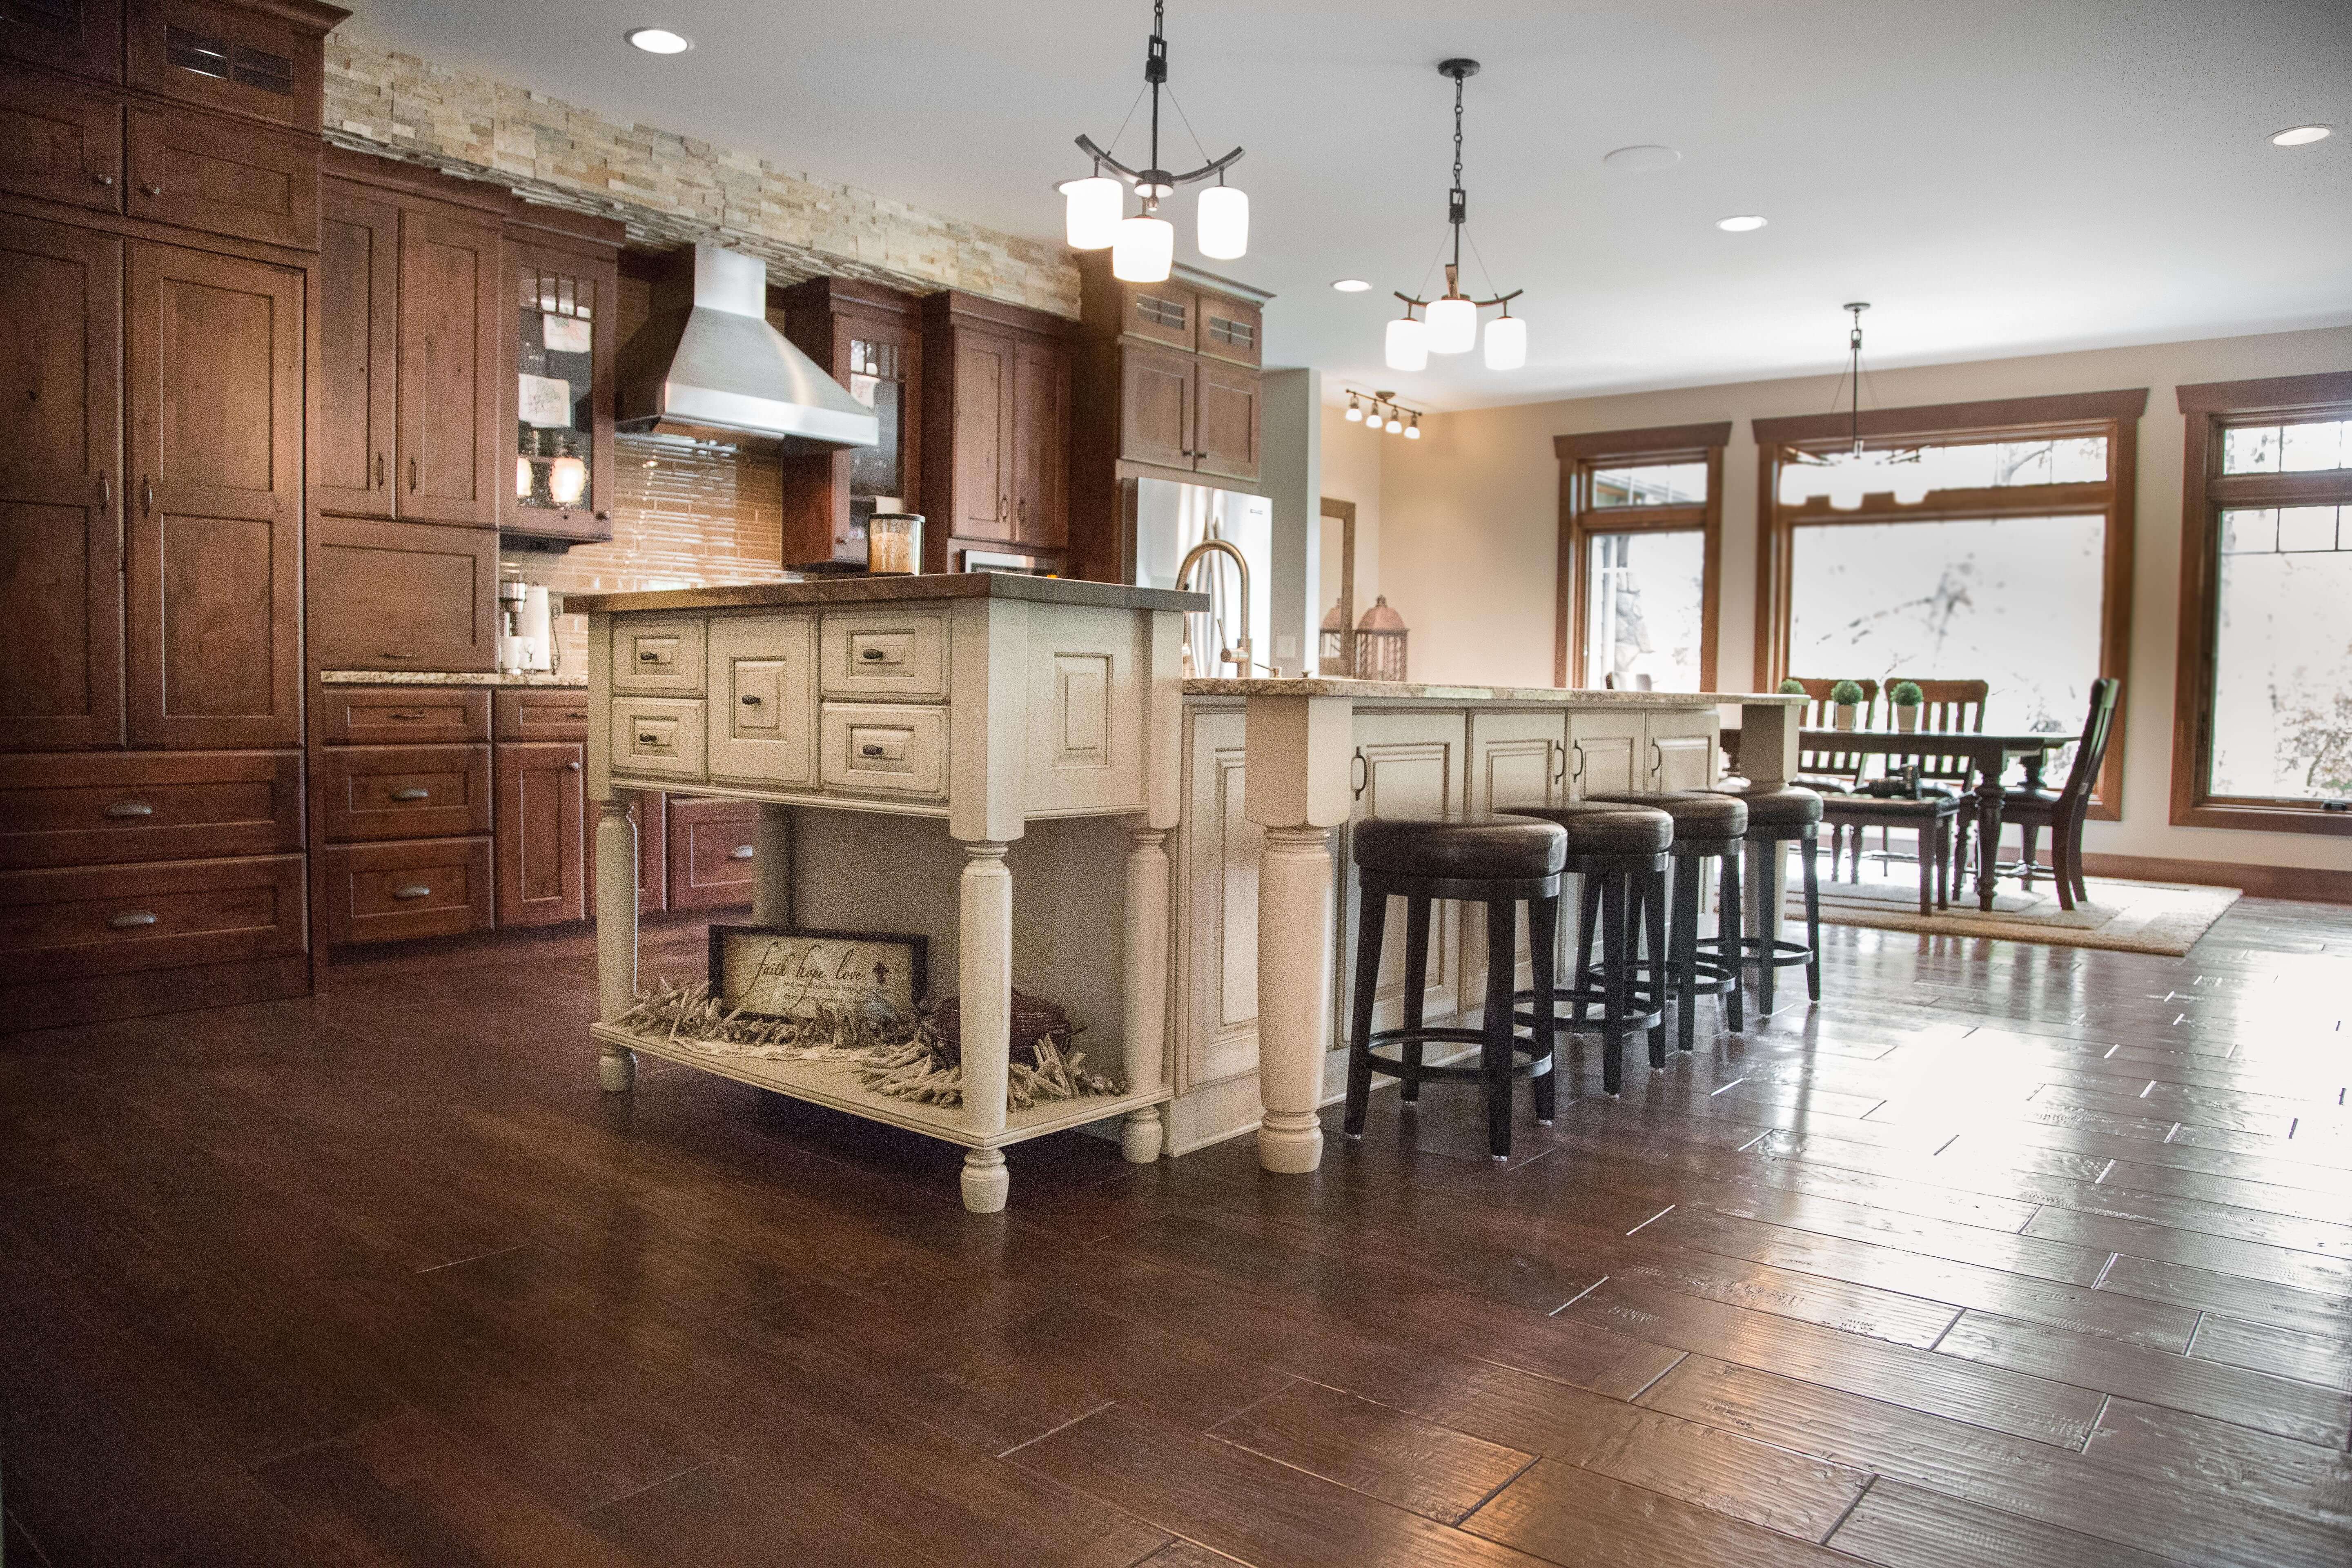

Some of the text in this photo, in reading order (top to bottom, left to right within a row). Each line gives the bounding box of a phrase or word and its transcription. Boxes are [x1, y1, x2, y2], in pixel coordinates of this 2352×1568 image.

[734, 941, 864, 1010] faith hope love
